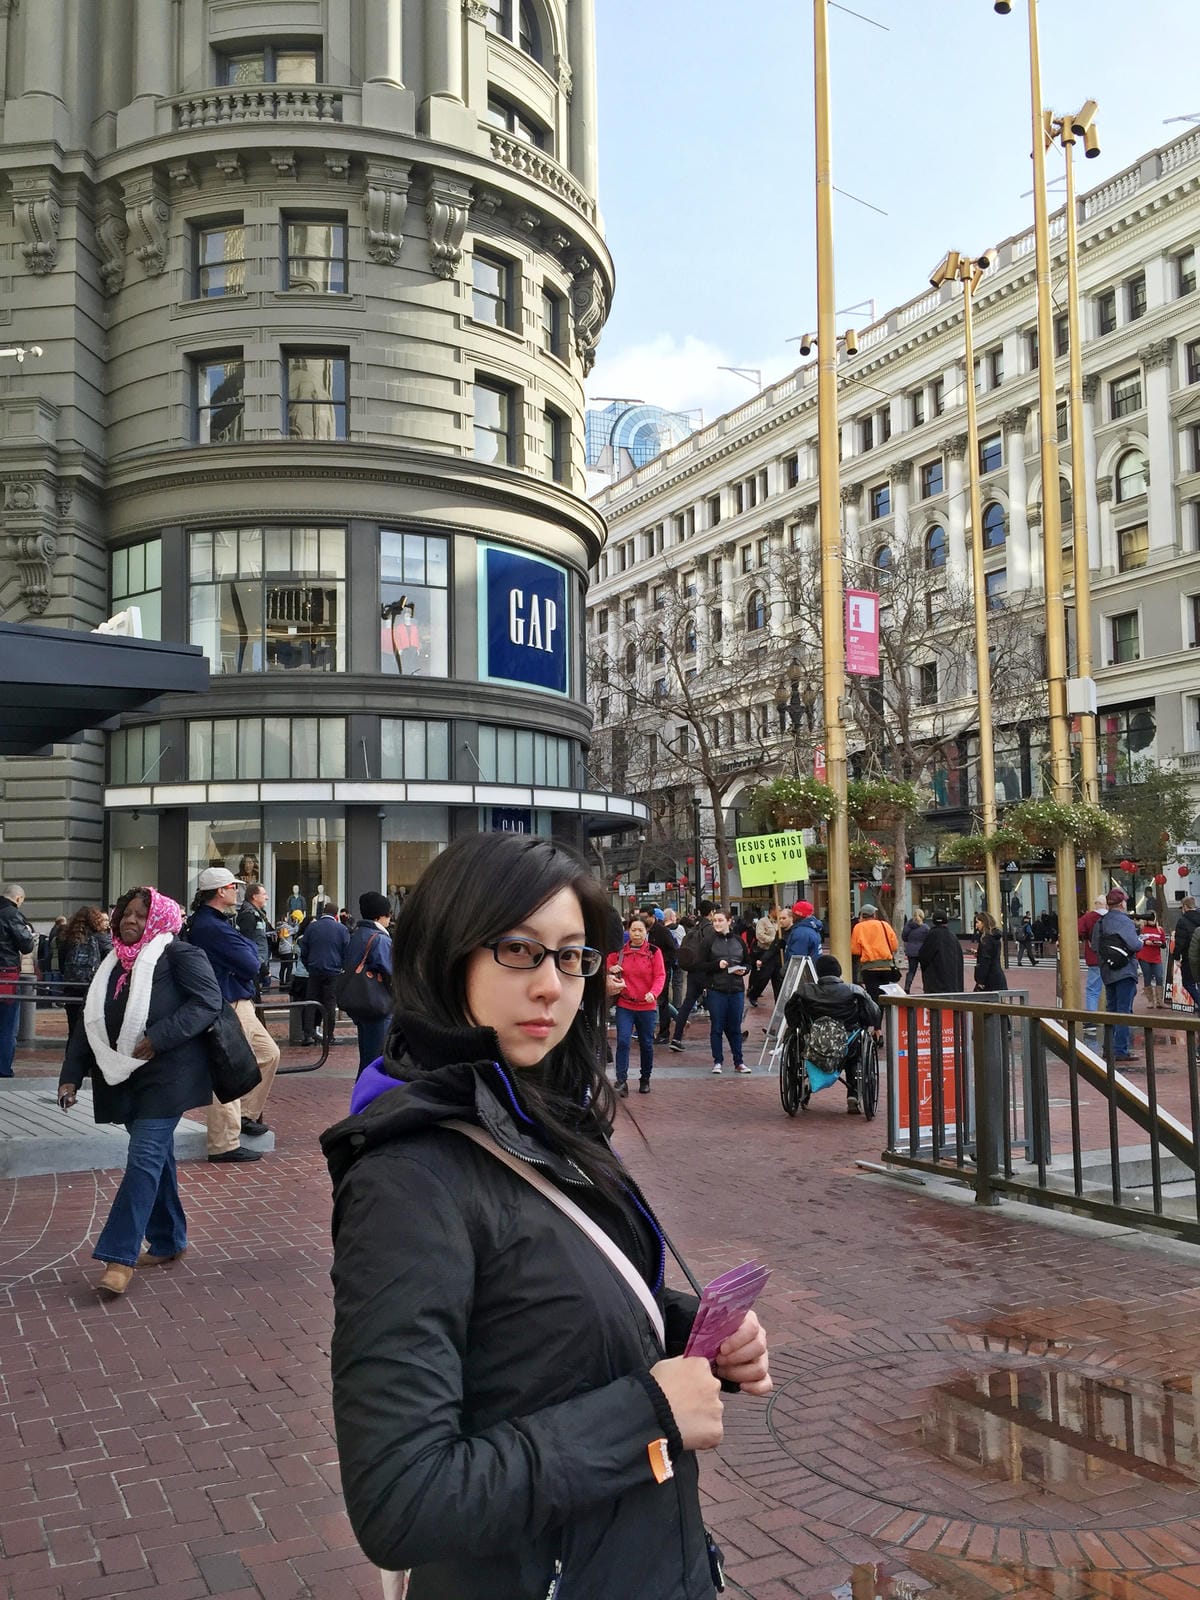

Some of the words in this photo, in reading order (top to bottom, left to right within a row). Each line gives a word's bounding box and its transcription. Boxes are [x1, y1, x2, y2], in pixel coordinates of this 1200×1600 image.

[510, 588, 557, 653] GAP
[738, 840, 765, 852] JESUS
[768, 835, 802, 848] CHRIST
[742, 852, 776, 865] LOVES
[782, 849, 802, 860] YOU
